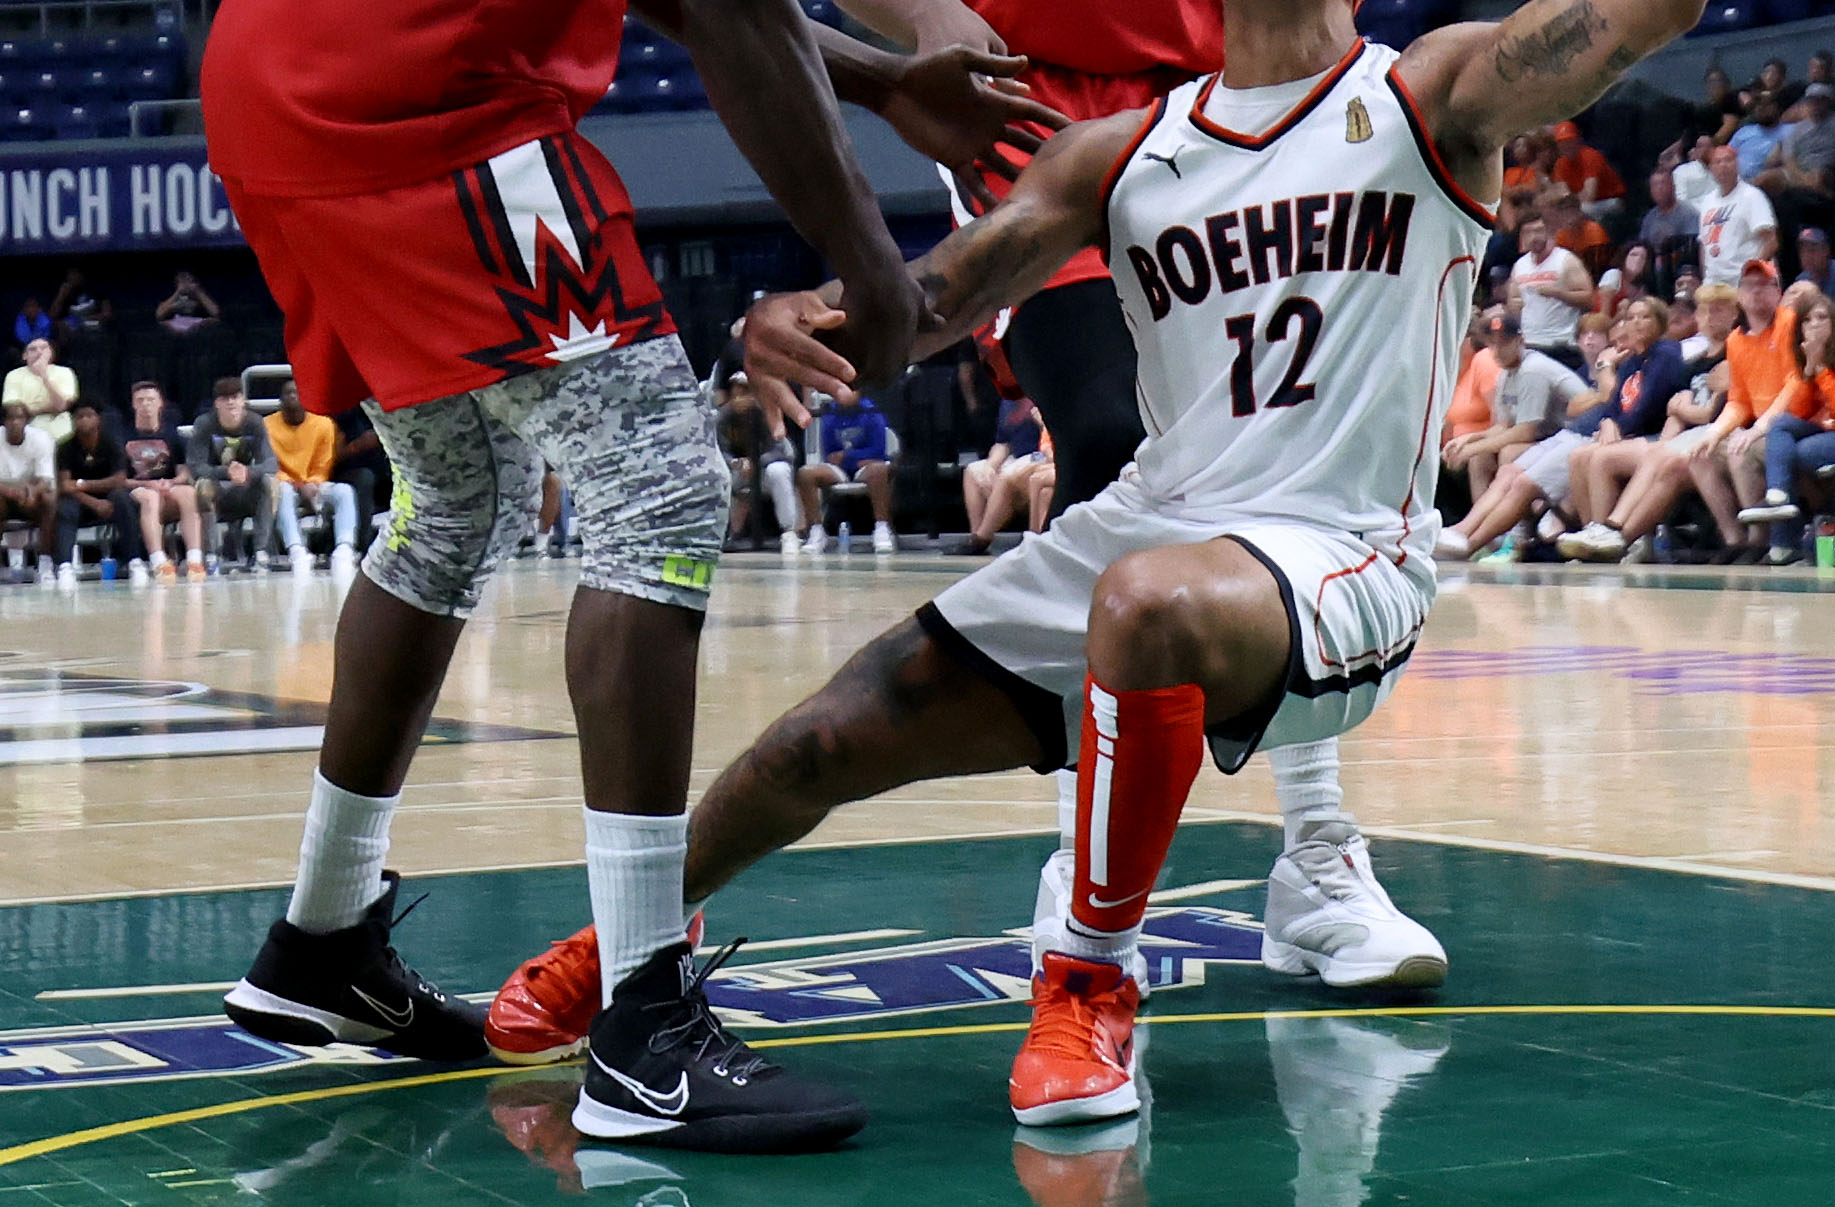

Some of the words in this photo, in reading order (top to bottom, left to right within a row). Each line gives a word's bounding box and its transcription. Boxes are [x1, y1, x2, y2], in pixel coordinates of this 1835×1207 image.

[0, 166, 111, 241] NCH
[131, 161, 243, 235] HOC
[1126, 189, 1417, 323] BOEHEIM
[1224, 294, 1324, 419] 12
